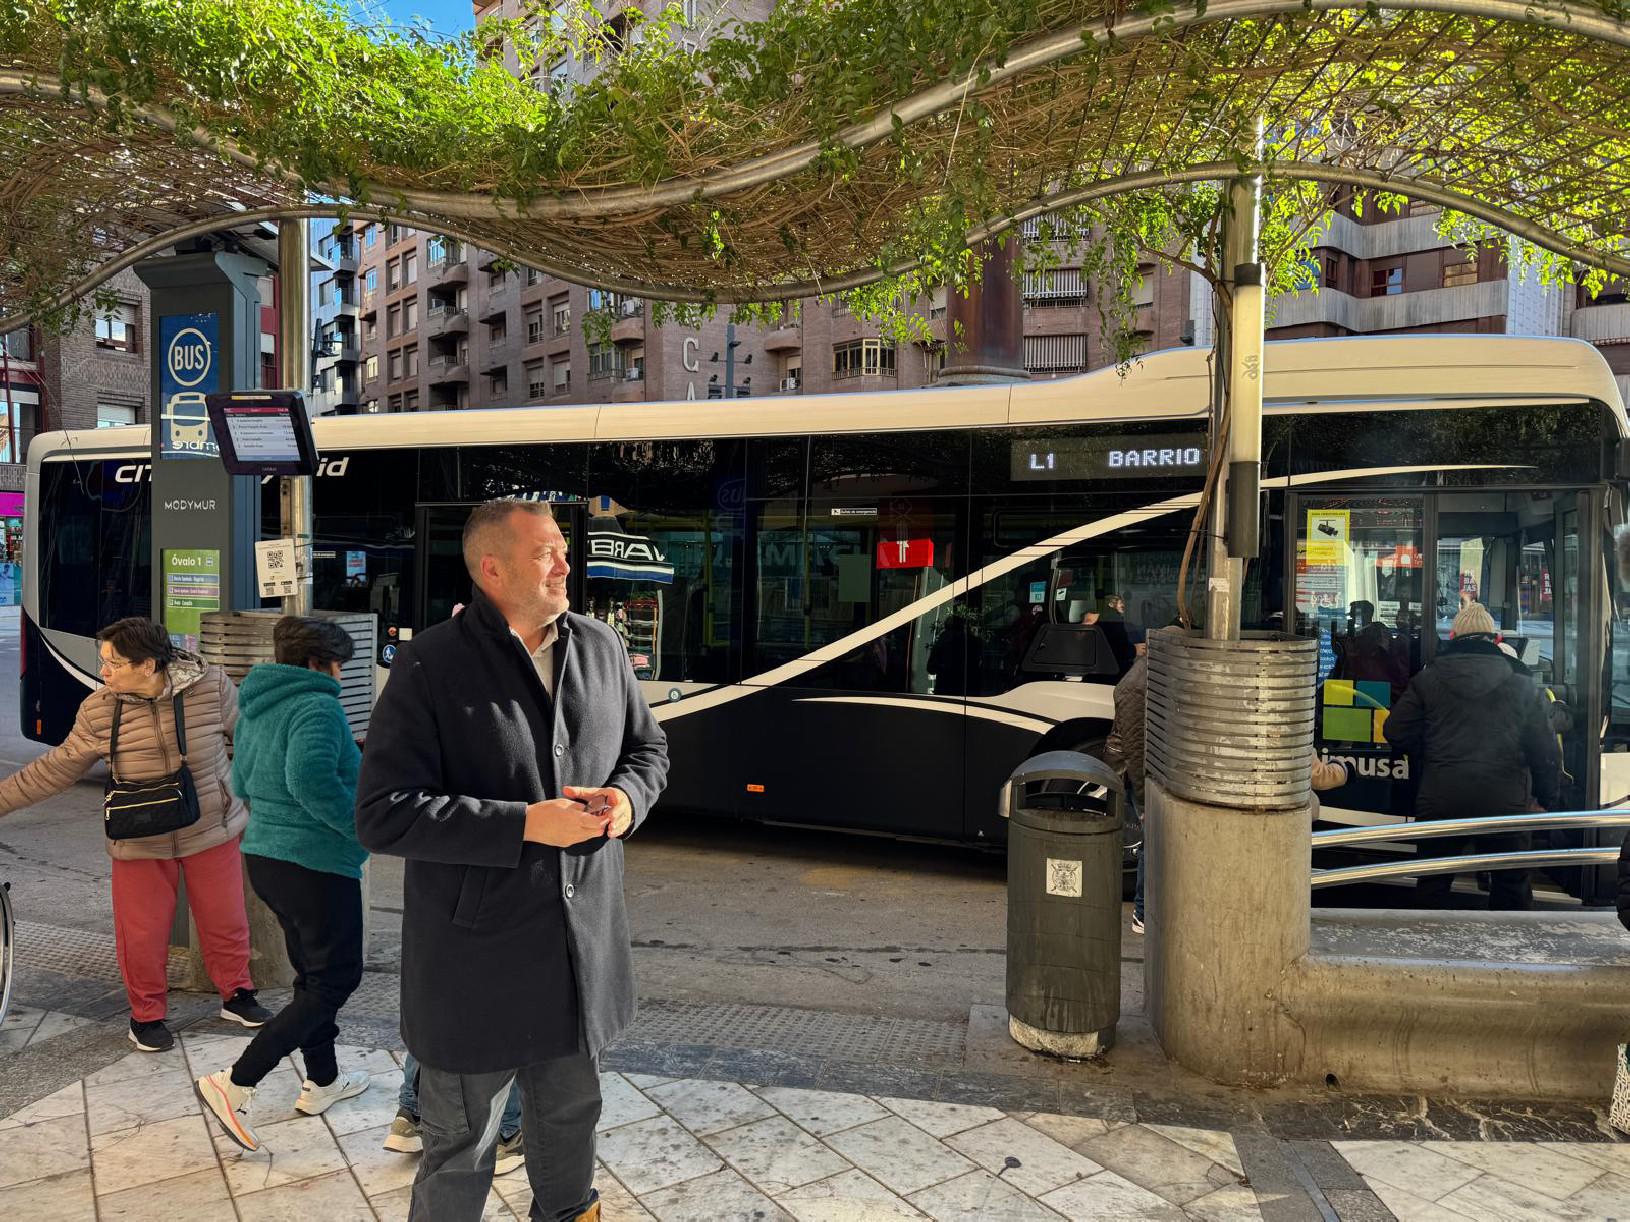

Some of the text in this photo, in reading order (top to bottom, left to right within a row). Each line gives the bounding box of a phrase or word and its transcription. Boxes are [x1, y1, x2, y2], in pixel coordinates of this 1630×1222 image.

[174, 345, 205, 371] BUS
[1029, 448, 1200, 470] L1 BARRIO
[164, 499, 216, 511] MODYMUR
[171, 553, 202, 567] Óvalo 1
